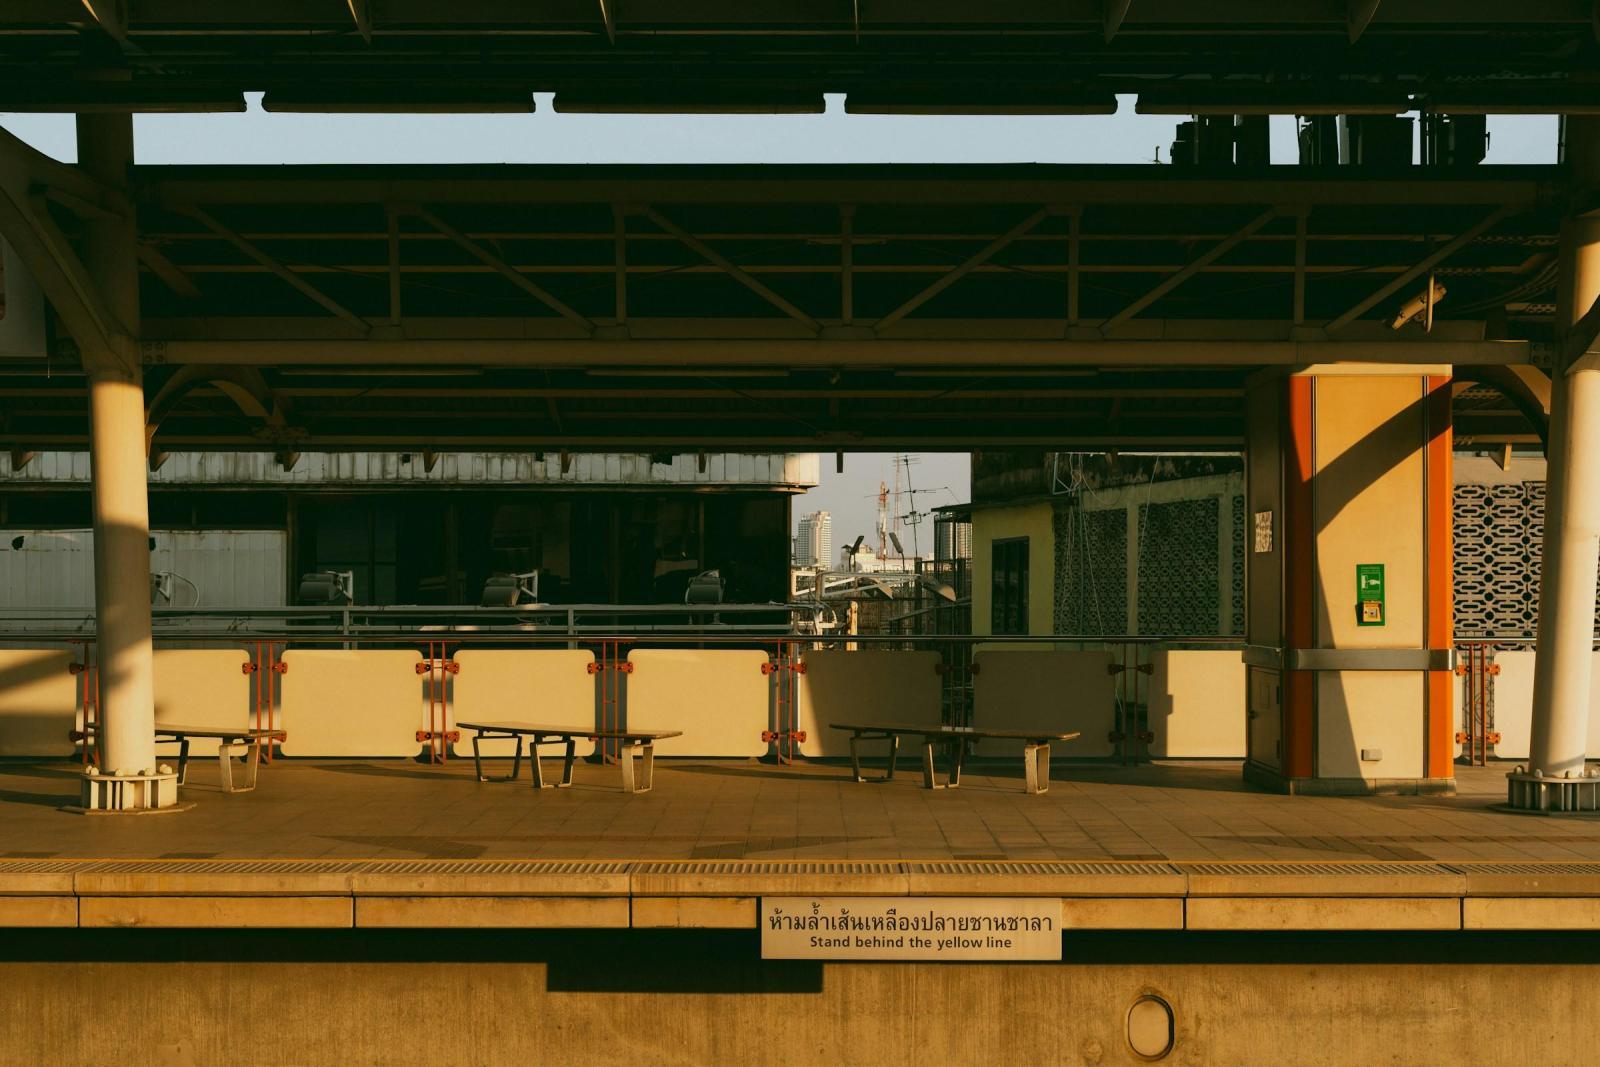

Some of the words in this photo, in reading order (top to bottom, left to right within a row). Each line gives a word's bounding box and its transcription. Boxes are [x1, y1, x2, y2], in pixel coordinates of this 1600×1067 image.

[768, 902, 1052, 931] ห้ามล้ำเส้นเหลืองปลายชานชาลา
[810, 936, 850, 948] Stand
[856, 936, 904, 948] behind
[909, 937, 932, 948] the
[938, 936, 983, 951] yellow
[986, 936, 1012, 948] line
